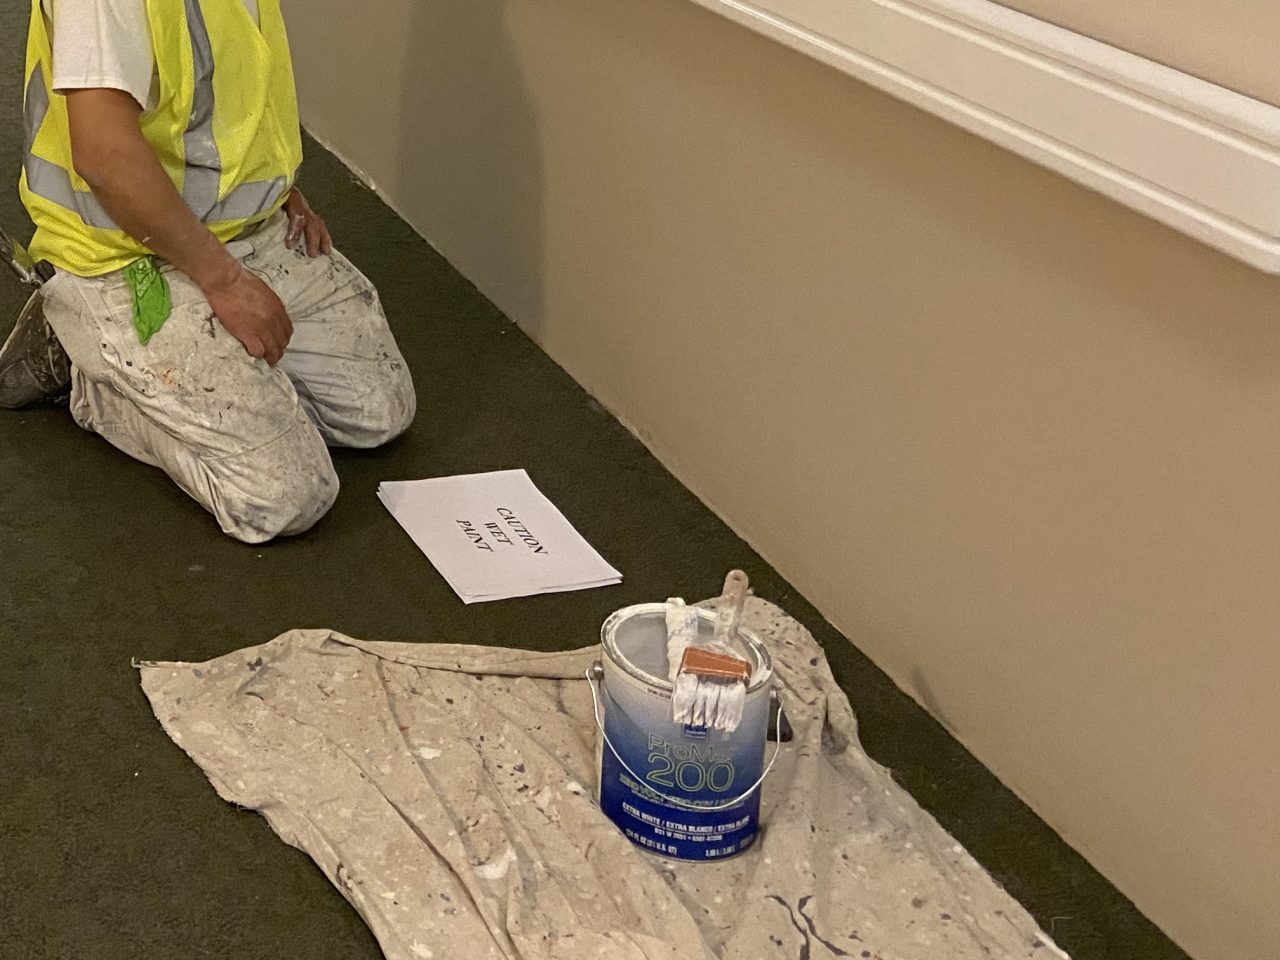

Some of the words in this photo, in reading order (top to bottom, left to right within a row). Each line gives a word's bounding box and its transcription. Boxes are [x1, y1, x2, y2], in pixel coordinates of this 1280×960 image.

[456, 518, 494, 552] PAINT
[483, 521, 513, 546] WET
[496, 507, 549, 555] CAUTION
[646, 752, 734, 793] 200
[666, 821, 687, 832] EXTRA
